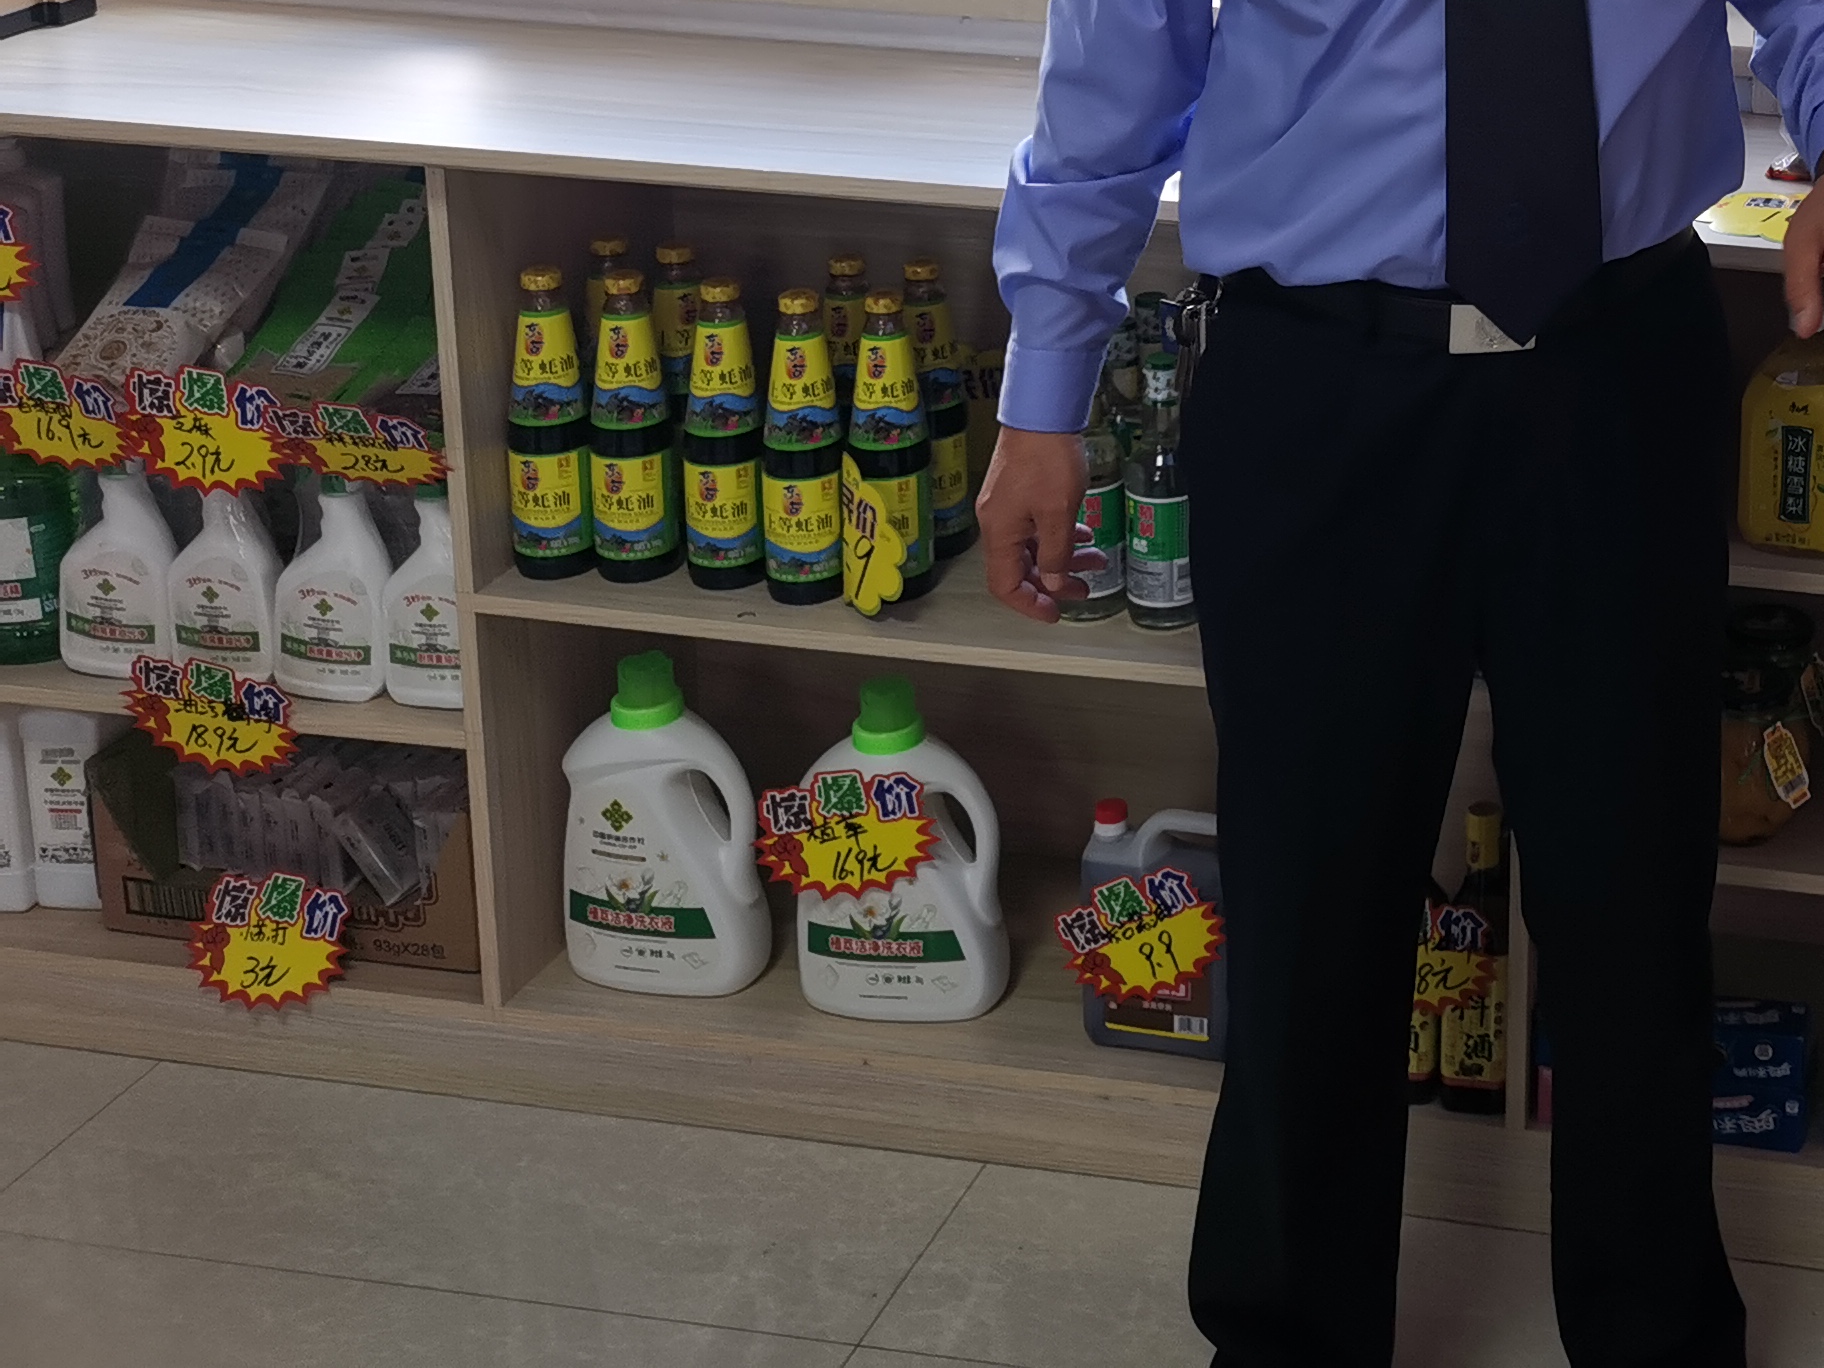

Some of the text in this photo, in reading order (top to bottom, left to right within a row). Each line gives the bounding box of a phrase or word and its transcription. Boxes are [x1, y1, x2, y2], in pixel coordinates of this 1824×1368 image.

[518, 353, 576, 376] 等蚝油
[600, 358, 658, 380] 等蚝油
[697, 364, 754, 386] 等蚝油
[859, 377, 915, 399] 等蚝油
[130, 367, 280, 431] 惊爆价
[267, 403, 430, 452] 惊爆价
[1785, 434, 1806, 517] 冰糖雪梨
[515, 491, 571, 510] 等蚝油
[137, 658, 287, 724] 惊爆价
[766, 773, 921, 834] 惊爆价
[213, 874, 348, 941] 惊爆价
[1057, 867, 1198, 953] 惊爆价
[241, 955, 292, 988] 3元
